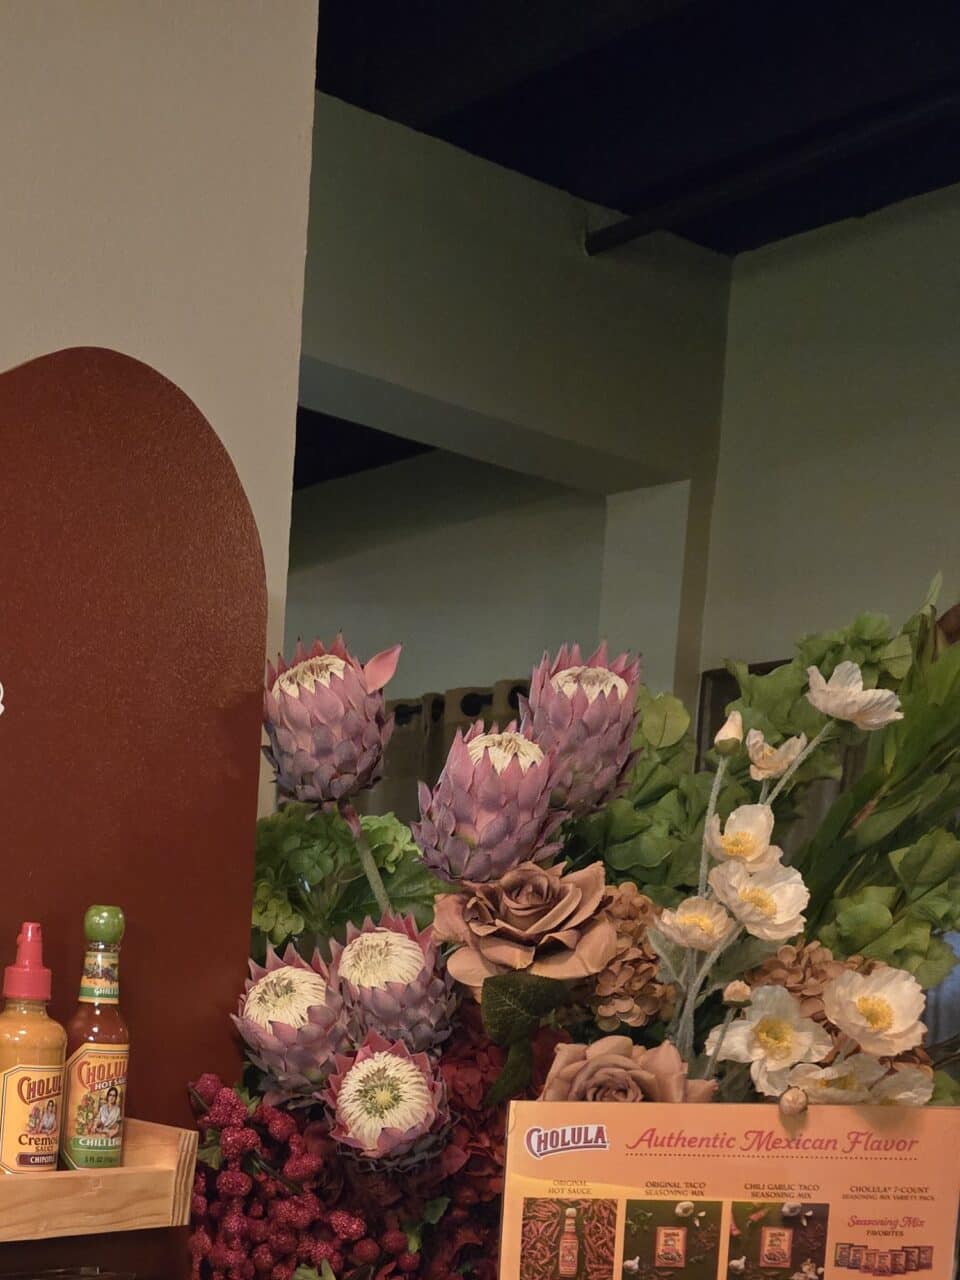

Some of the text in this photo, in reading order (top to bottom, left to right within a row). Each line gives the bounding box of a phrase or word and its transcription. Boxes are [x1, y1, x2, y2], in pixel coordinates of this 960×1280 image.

[95, 1081, 113, 1090] HOT
[79, 1138, 105, 1146] CHILI
[526, 1126, 919, 1159] CHOLULA Authentic Mexican Flavor
[552, 1179, 587, 1187] ORIGINAL
[848, 1215, 925, 1229] Seasoning Mix
